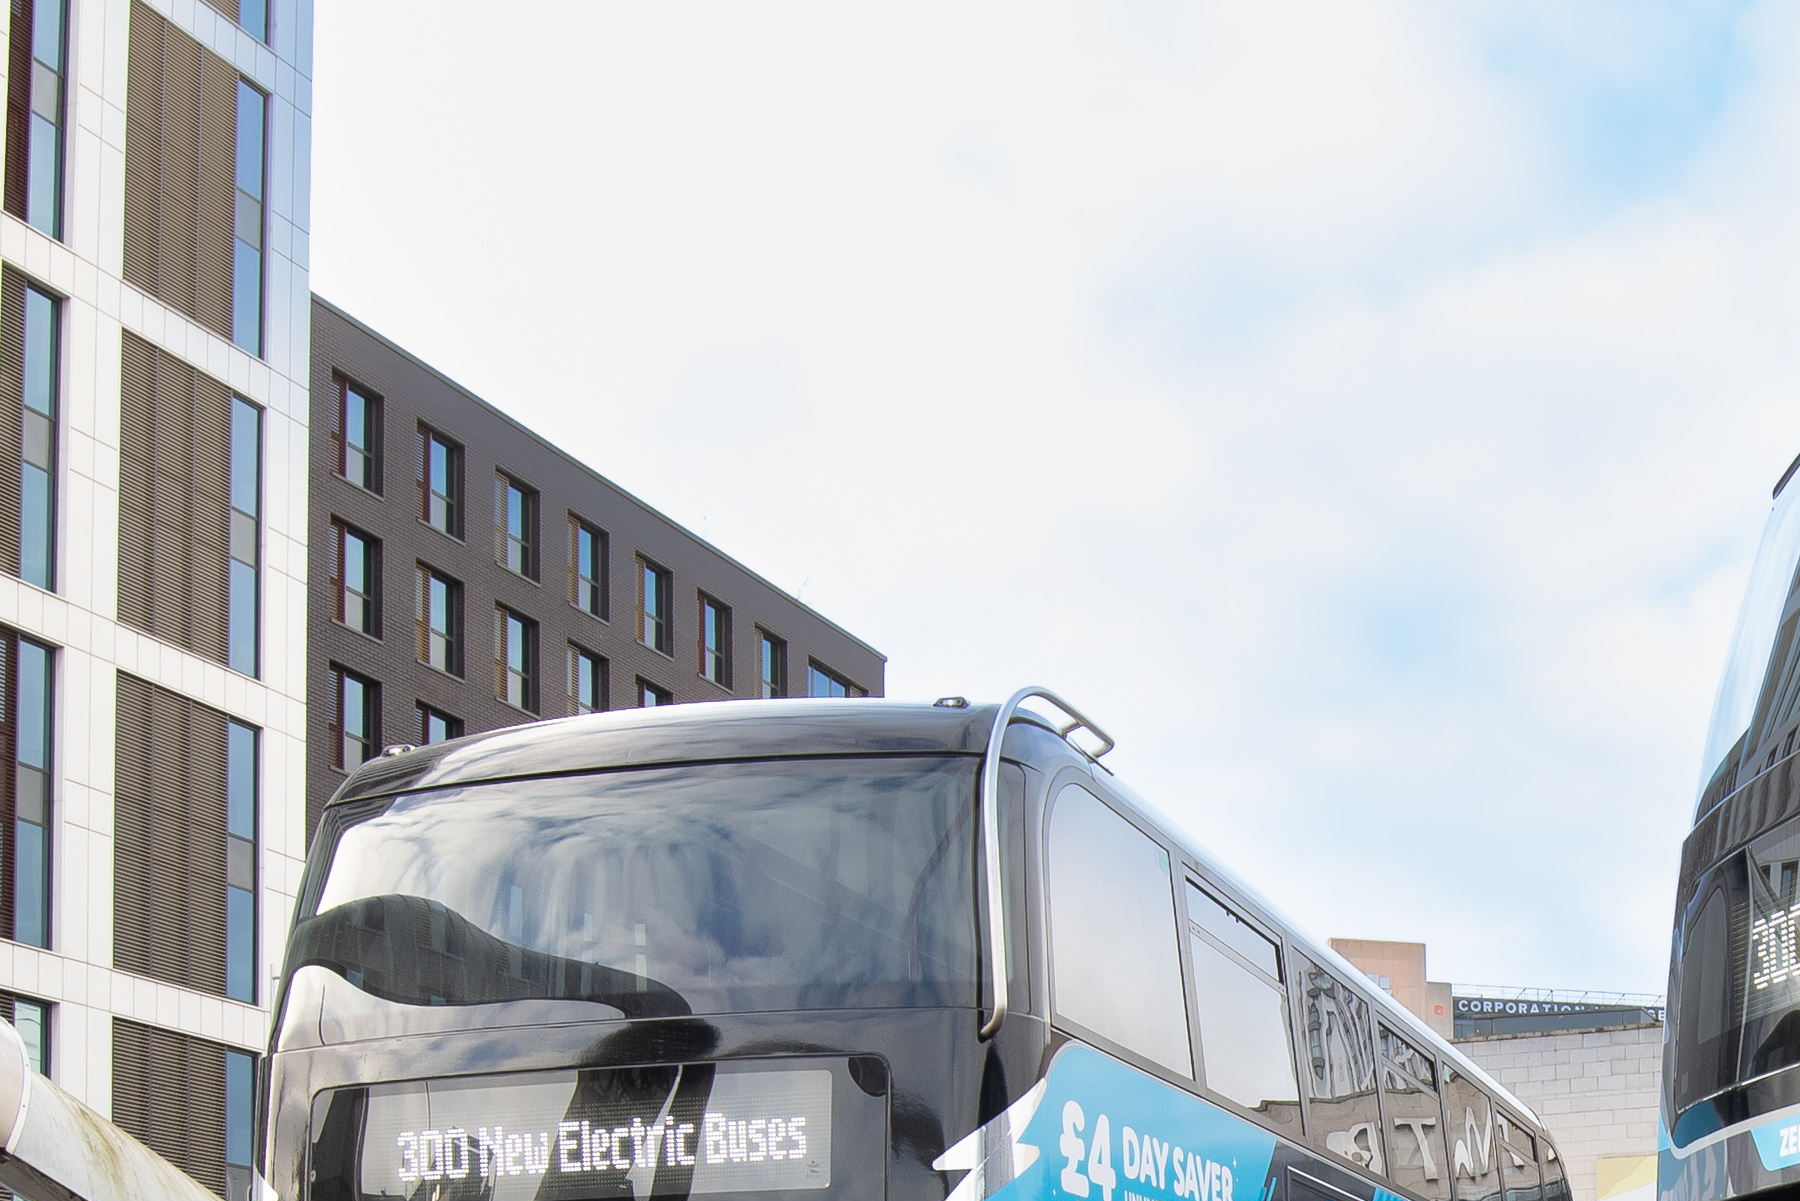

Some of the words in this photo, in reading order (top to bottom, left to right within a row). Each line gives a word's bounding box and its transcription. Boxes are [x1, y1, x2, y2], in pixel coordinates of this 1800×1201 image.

[396, 1128, 470, 1183] 300
[478, 1124, 550, 1178] New
[558, 1114, 696, 1173] Electric
[704, 1112, 808, 1165] Buses
[1122, 1125, 1169, 1191] DAY
